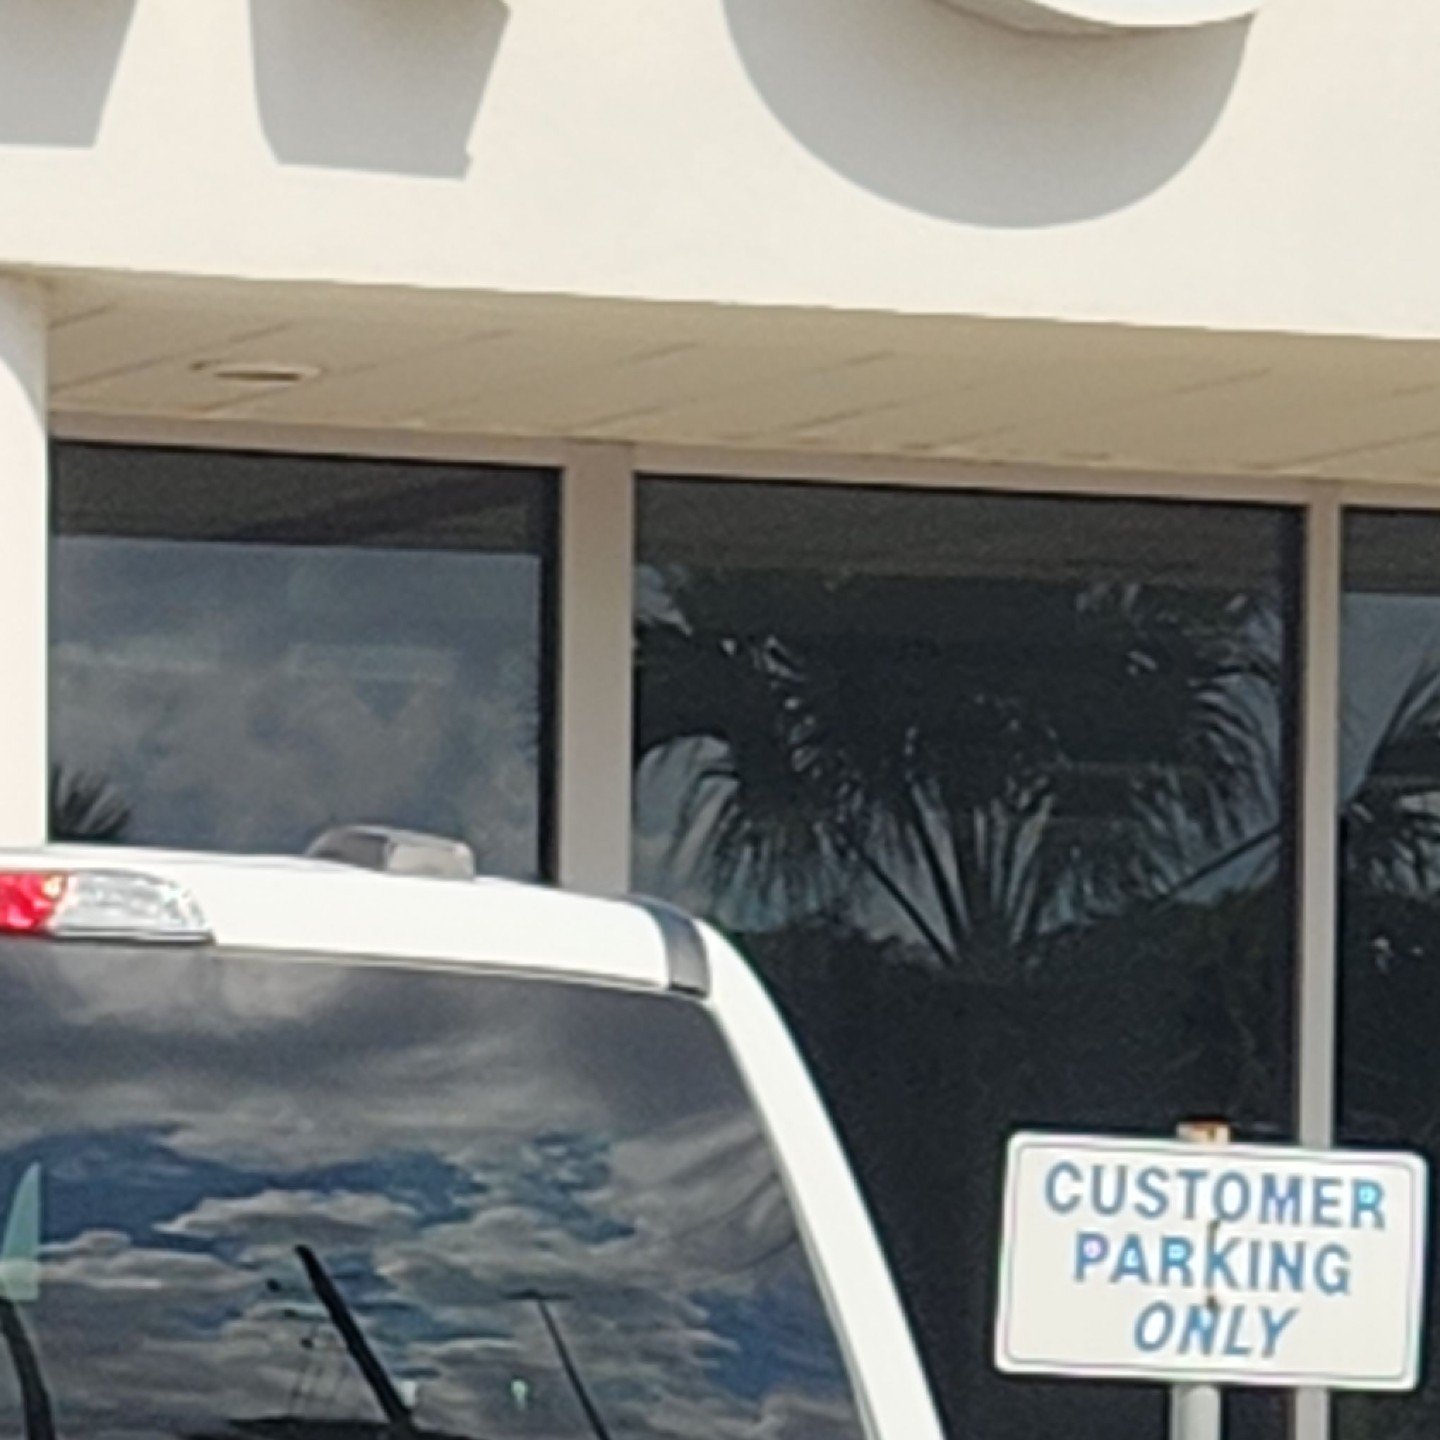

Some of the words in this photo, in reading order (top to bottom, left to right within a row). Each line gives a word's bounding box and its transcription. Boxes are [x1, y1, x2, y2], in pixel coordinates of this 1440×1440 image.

[1044, 1160, 1386, 1230] CUSTOMER
[1073, 1233, 1352, 1296] PARKING
[1133, 1300, 1300, 1359] ONLY
